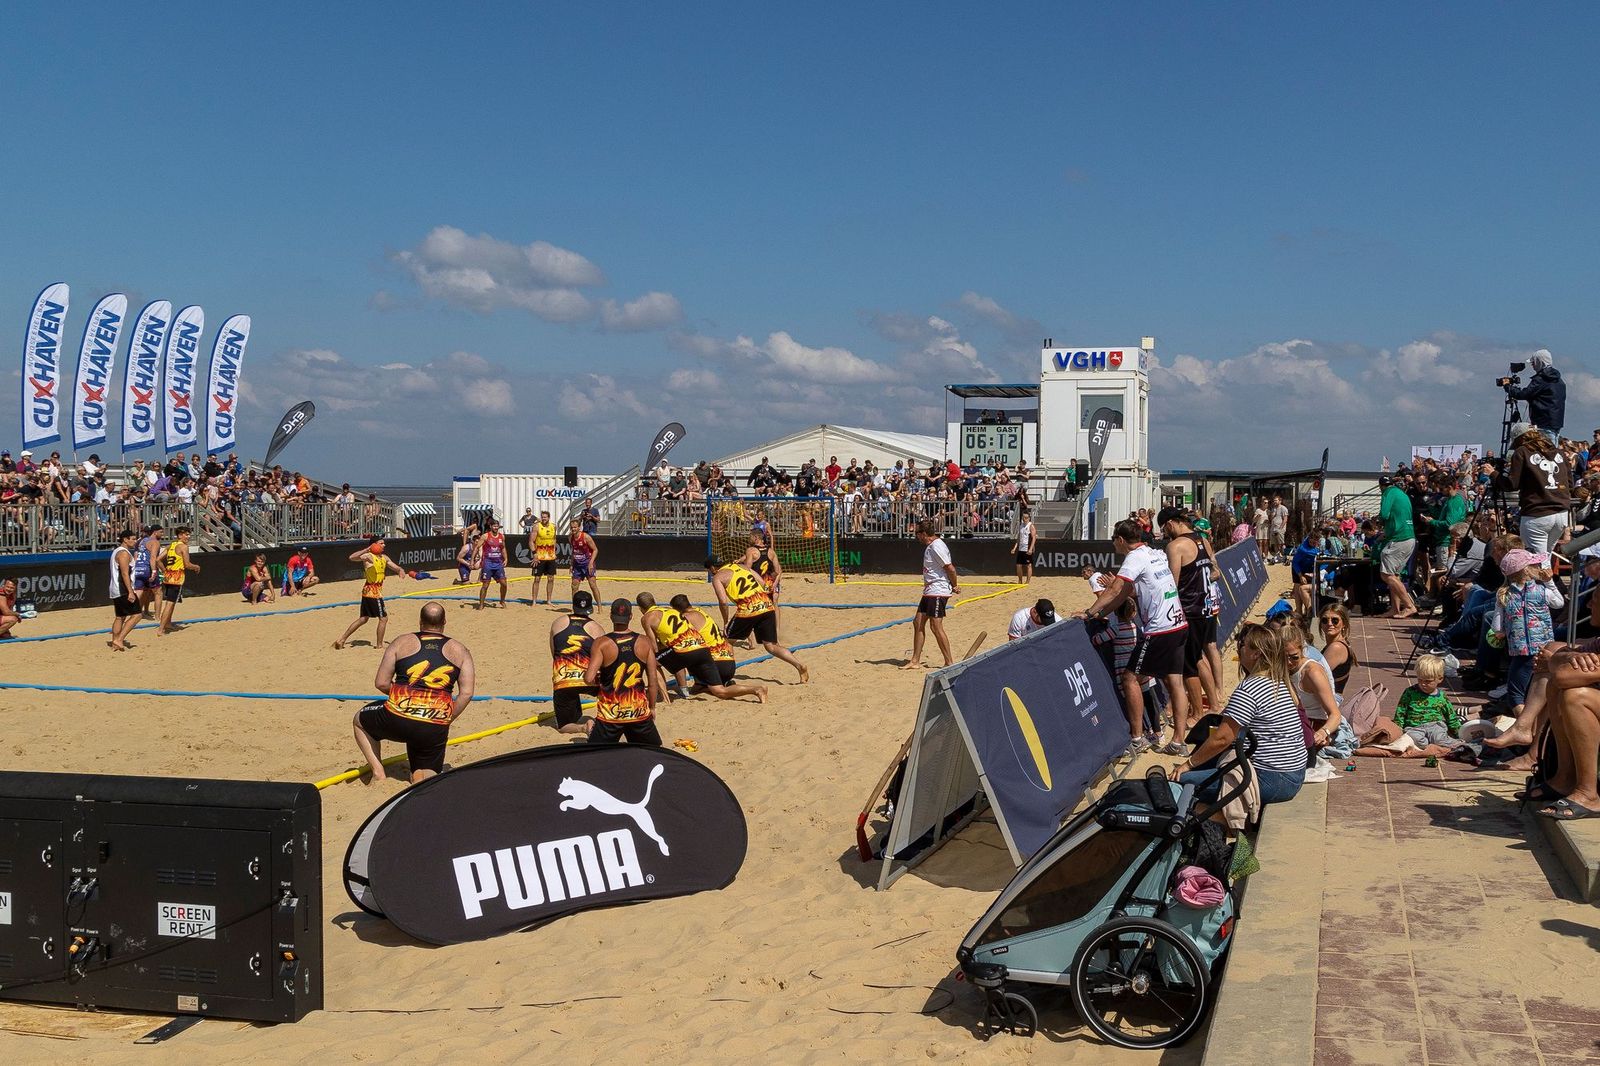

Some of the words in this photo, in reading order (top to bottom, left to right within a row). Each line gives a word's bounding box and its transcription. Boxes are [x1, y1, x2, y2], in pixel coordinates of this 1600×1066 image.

[29, 301, 65, 428] CUXHAVEN
[81, 309, 121, 430] CUXHAVEN
[1055, 351, 1106, 368] VGH
[130, 314, 166, 433] CUXHAVEN
[168, 321, 201, 435] CUXHAVEN
[212, 329, 246, 439] CUXHAVEN
[282, 410, 305, 434] DHB
[1092, 419, 1106, 446] DHB
[655, 430, 675, 453] DHB
[535, 488, 586, 498] CUXHAVEN
[398, 547, 457, 565] AIRBOWL.NET
[736, 574, 759, 596] 23
[406, 660, 454, 688] 16
[613, 662, 643, 692] 12
[403, 706, 450, 720] DEVILS
[1127, 815, 1150, 823] THULE
[452, 828, 645, 920] PUMA
[162, 906, 211, 921] SCREEN
[169, 921, 204, 936] RENT
